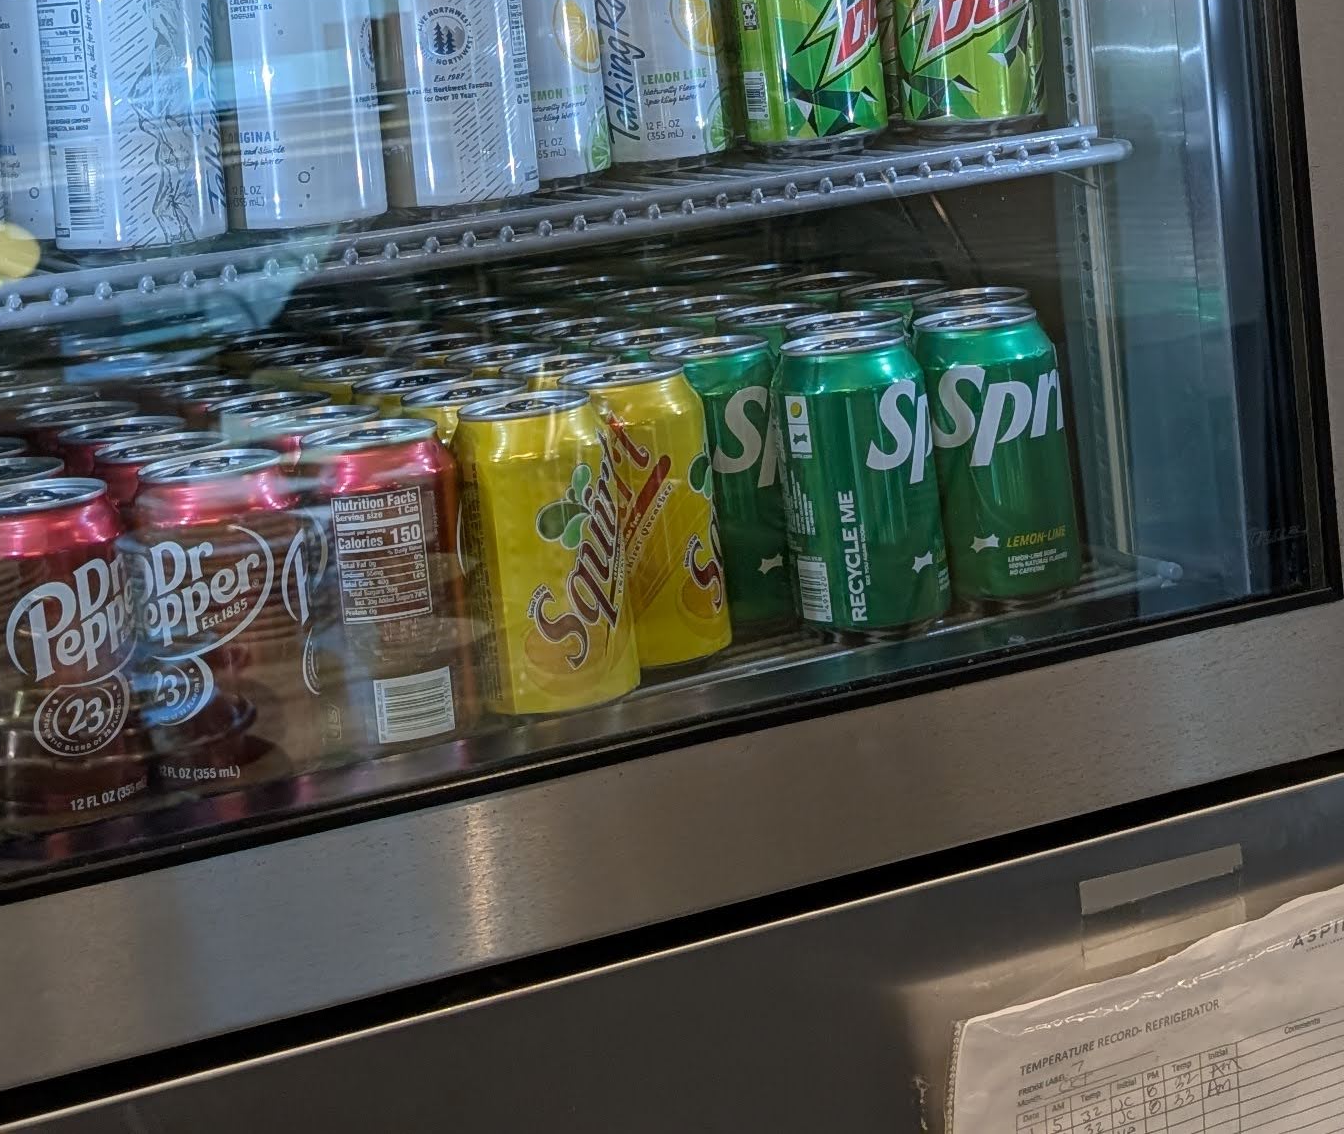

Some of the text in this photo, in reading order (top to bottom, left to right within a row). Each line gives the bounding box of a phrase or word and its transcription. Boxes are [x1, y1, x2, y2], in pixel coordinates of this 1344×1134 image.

[70, 9, 79, 24] 0
[418, 7, 472, 31] LIVE NORTHWEST
[436, 36, 473, 65] NORTHWEST
[641, 68, 707, 85] LEMON LIME
[604, 36, 645, 144] Talking
[642, 87, 676, 98] Naturally
[644, 98, 677, 108] Sparkling
[646, 119, 680, 130] 12 FL OZ
[539, 138, 563, 148] FL OZ
[647, 129, 684, 141] (355 mL)
[550, 147, 567, 158] mL)
[252, 185, 261, 194] OZ
[334, 491, 417, 512] Nutrition Facts
[404, 505, 418, 513] Can
[336, 511, 383, 523] Serving size
[337, 524, 420, 550] Calories 150
[1006, 525, 1066, 547] LEMON-LIME
[837, 490, 868, 623] RECYCLE ME
[150, 540, 213, 596] Dr
[73, 553, 128, 616] Dr
[66, 697, 105, 735] 23
[64, 742, 92, 752] BLEND
[93, 736, 102, 745] OF
[168, 765, 241, 781] FL OZ (355 mL)
[70, 800, 84, 810] 12
[87, 796, 99, 807] FL
[102, 790, 115, 804] OZ
[1020, 1040, 1095, 1076] TEMPERATURE
[1145, 999, 1220, 1033] REFRIGERATOR
[1023, 1113, 1039, 1123] Date
[1051, 1102, 1065, 1112] AM
[1080, 1091, 1101, 1102] Temp
[1146, 1071, 1159, 1081] PM
[1172, 1061, 1192, 1073] Temp
[1208, 1048, 1228, 1060] Initial
[1284, 1017, 1321, 1034] Comments
[1018, 1081, 1044, 1097] FRIDGE
[1053, 1116, 1063, 1133] 5
[1080, 1107, 1101, 1123] 32
[1175, 1073, 1199, 1090] 32
[1174, 1090, 1195, 1107] 33
